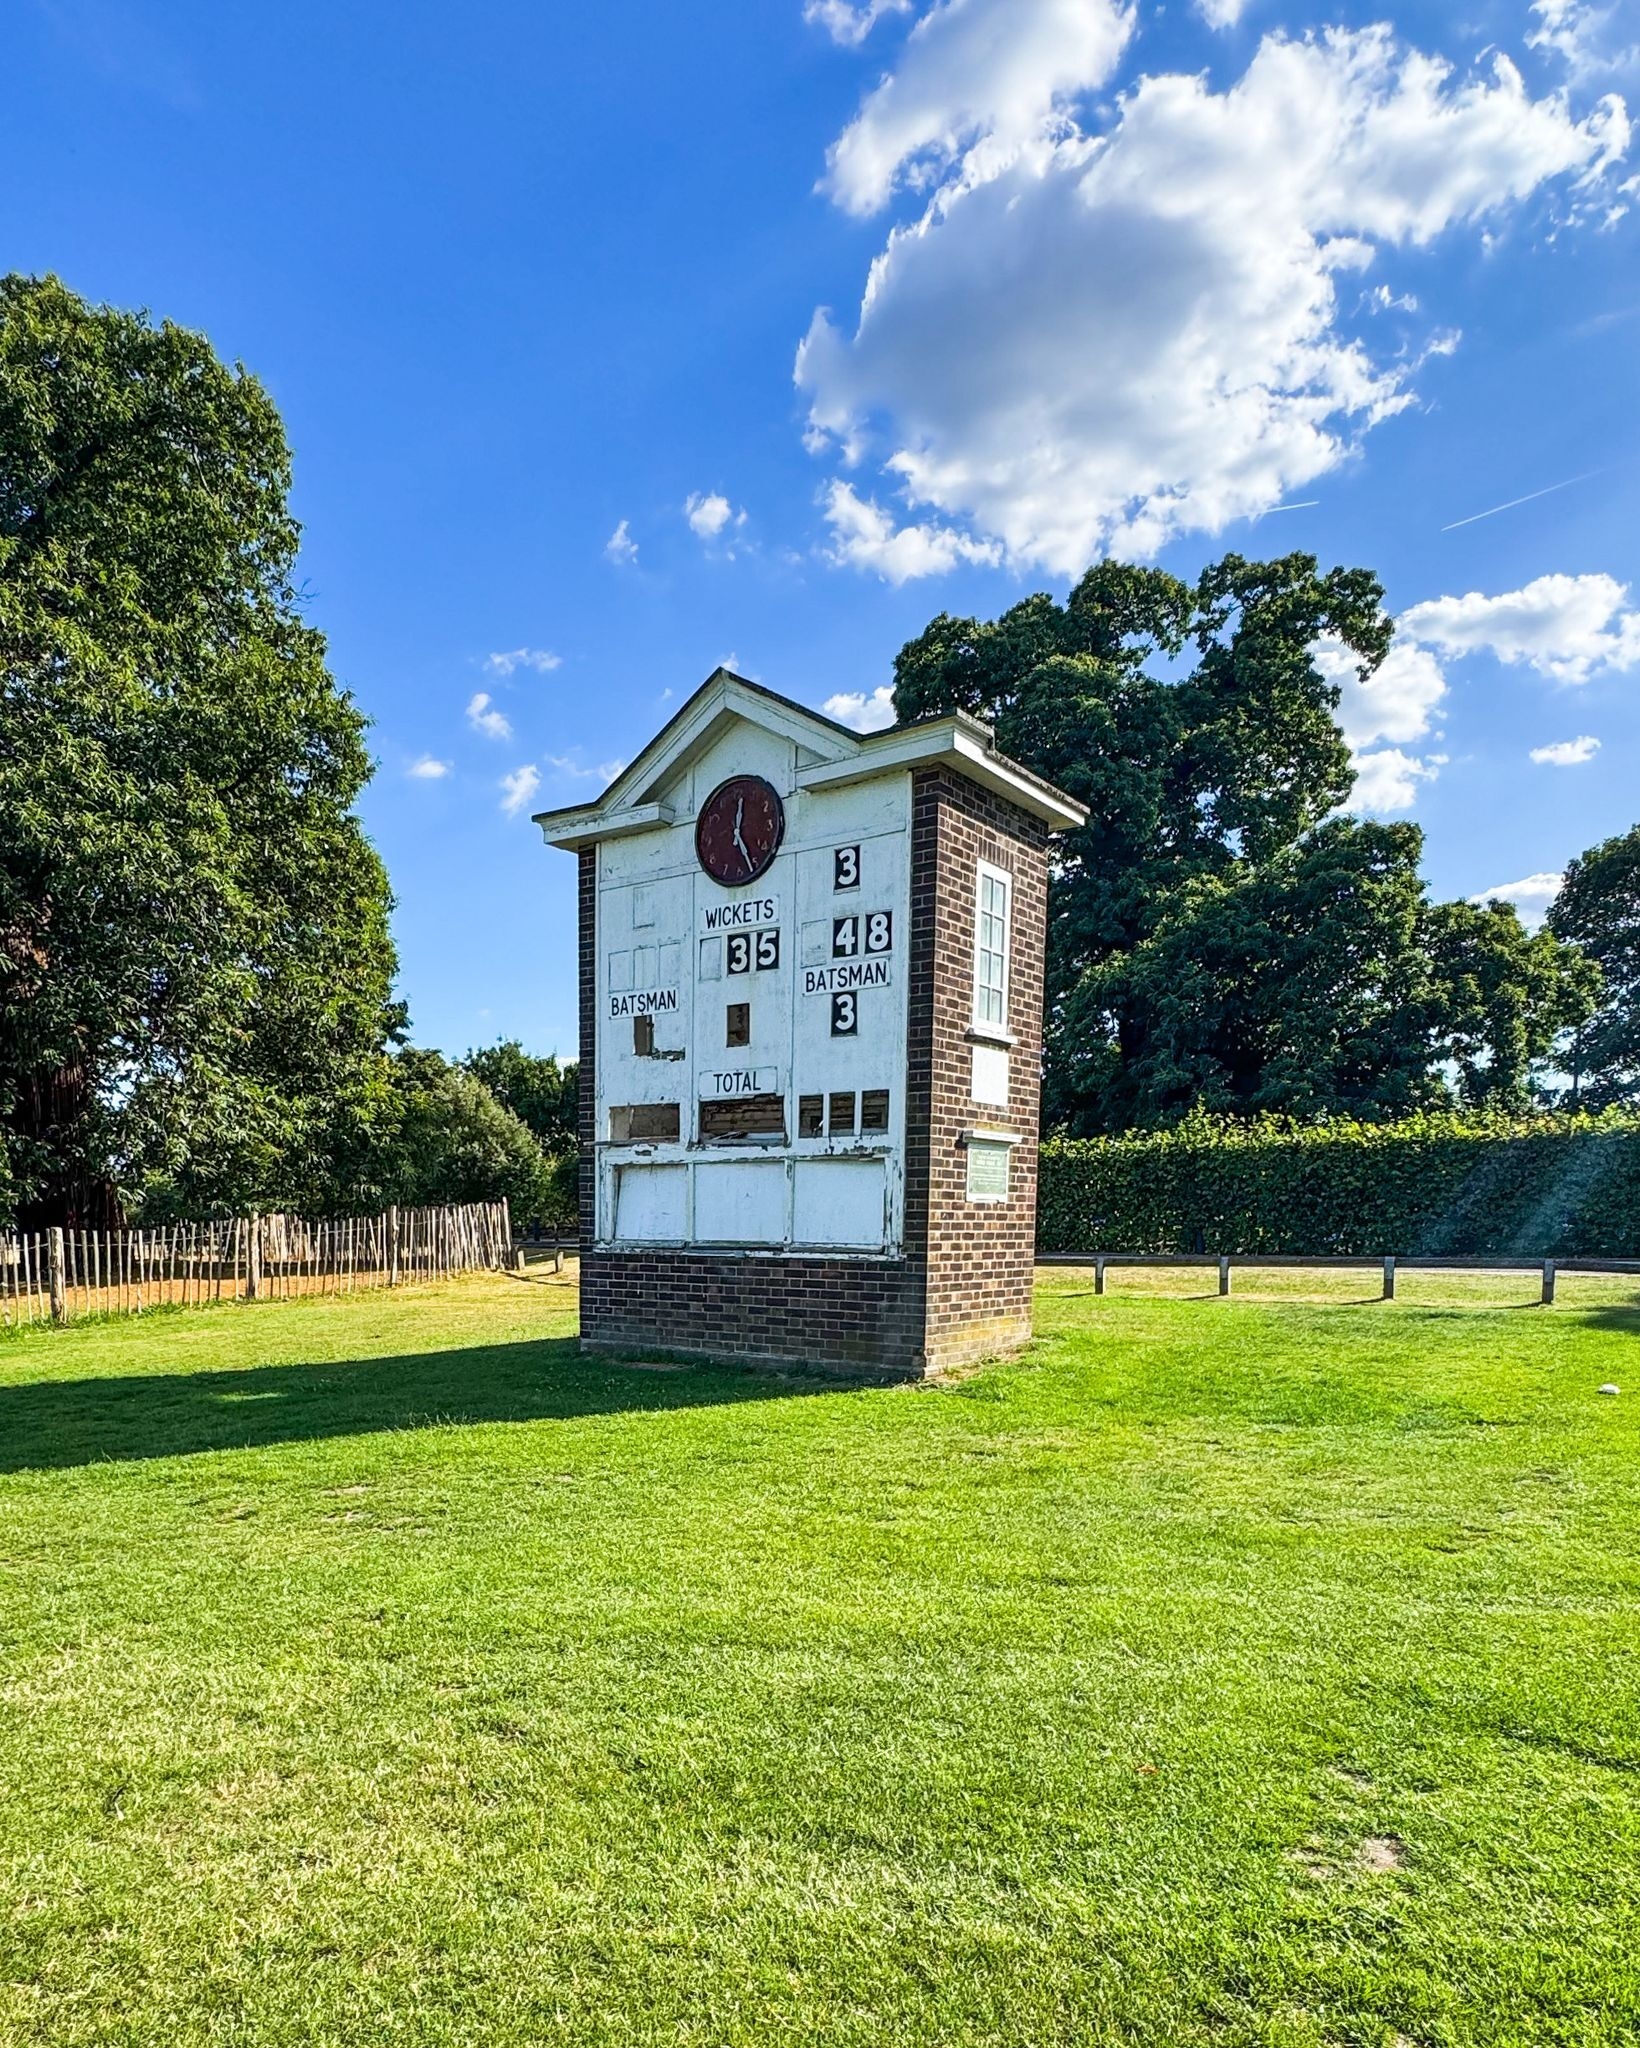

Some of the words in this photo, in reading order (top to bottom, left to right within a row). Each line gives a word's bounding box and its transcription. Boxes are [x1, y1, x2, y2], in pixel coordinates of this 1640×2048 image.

[838, 848, 857, 885] 3
[705, 899, 774, 929] WICKETS
[806, 961, 887, 992] BATSMAN
[611, 989, 676, 1016] BATSMAN
[835, 993, 855, 1030] 3
[713, 1071, 761, 1093] TOTAL
